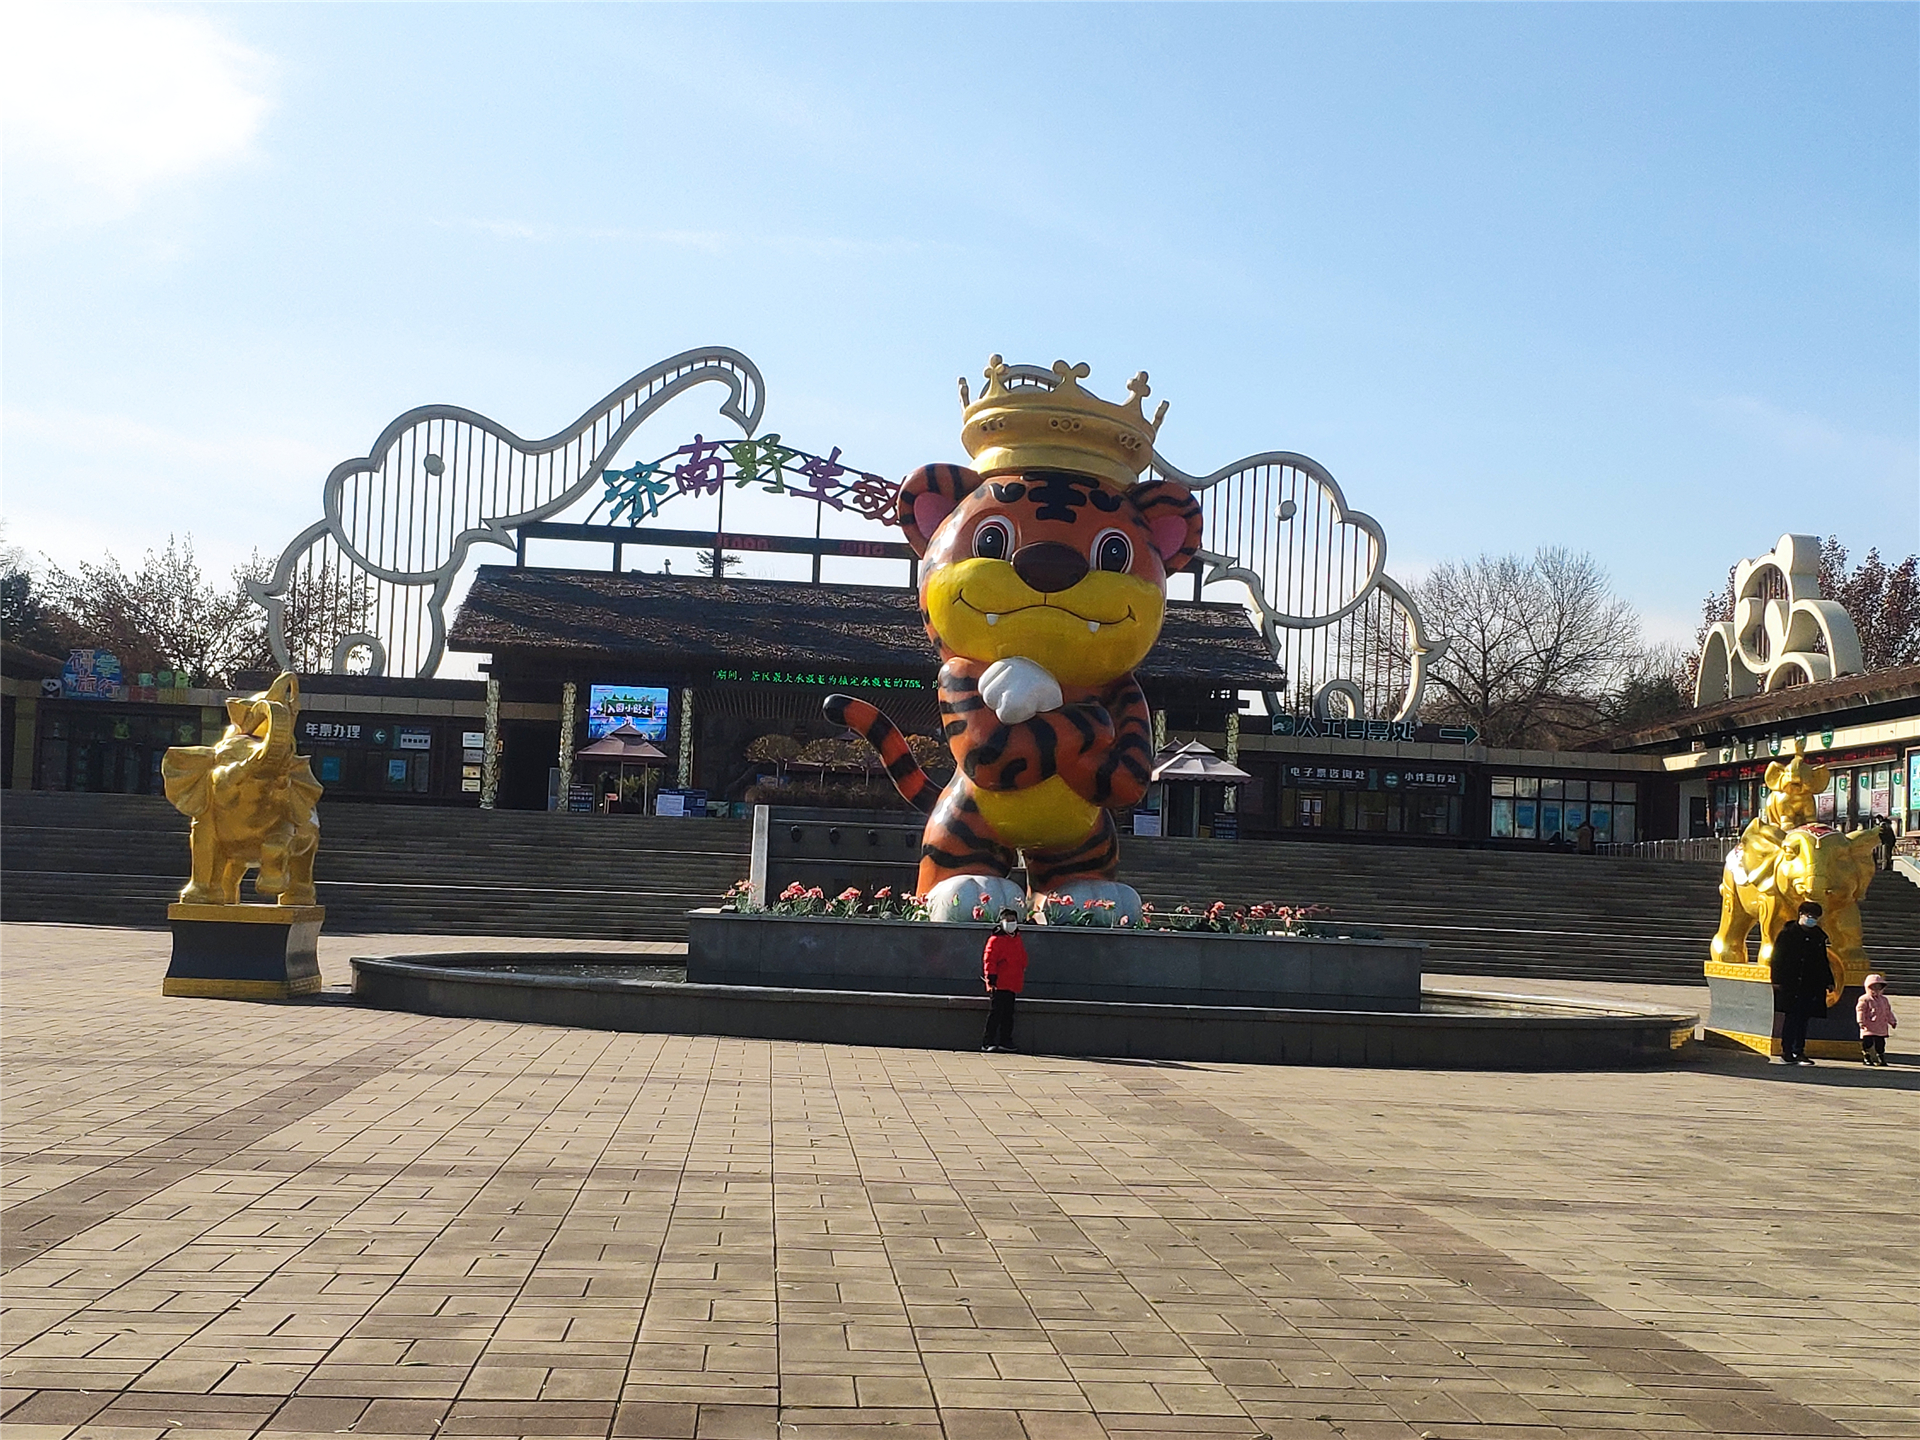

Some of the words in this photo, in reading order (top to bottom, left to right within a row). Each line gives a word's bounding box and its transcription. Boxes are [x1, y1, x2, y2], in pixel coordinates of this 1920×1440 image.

[67, 648, 121, 678] 研学
[76, 669, 121, 698] 旅行
[607, 702, 651, 716] 入园小贴士
[305, 722, 361, 739] 年票办理
[1296, 715, 1415, 743] 人工售票处
[1404, 771, 1458, 784] 小件寄存处
